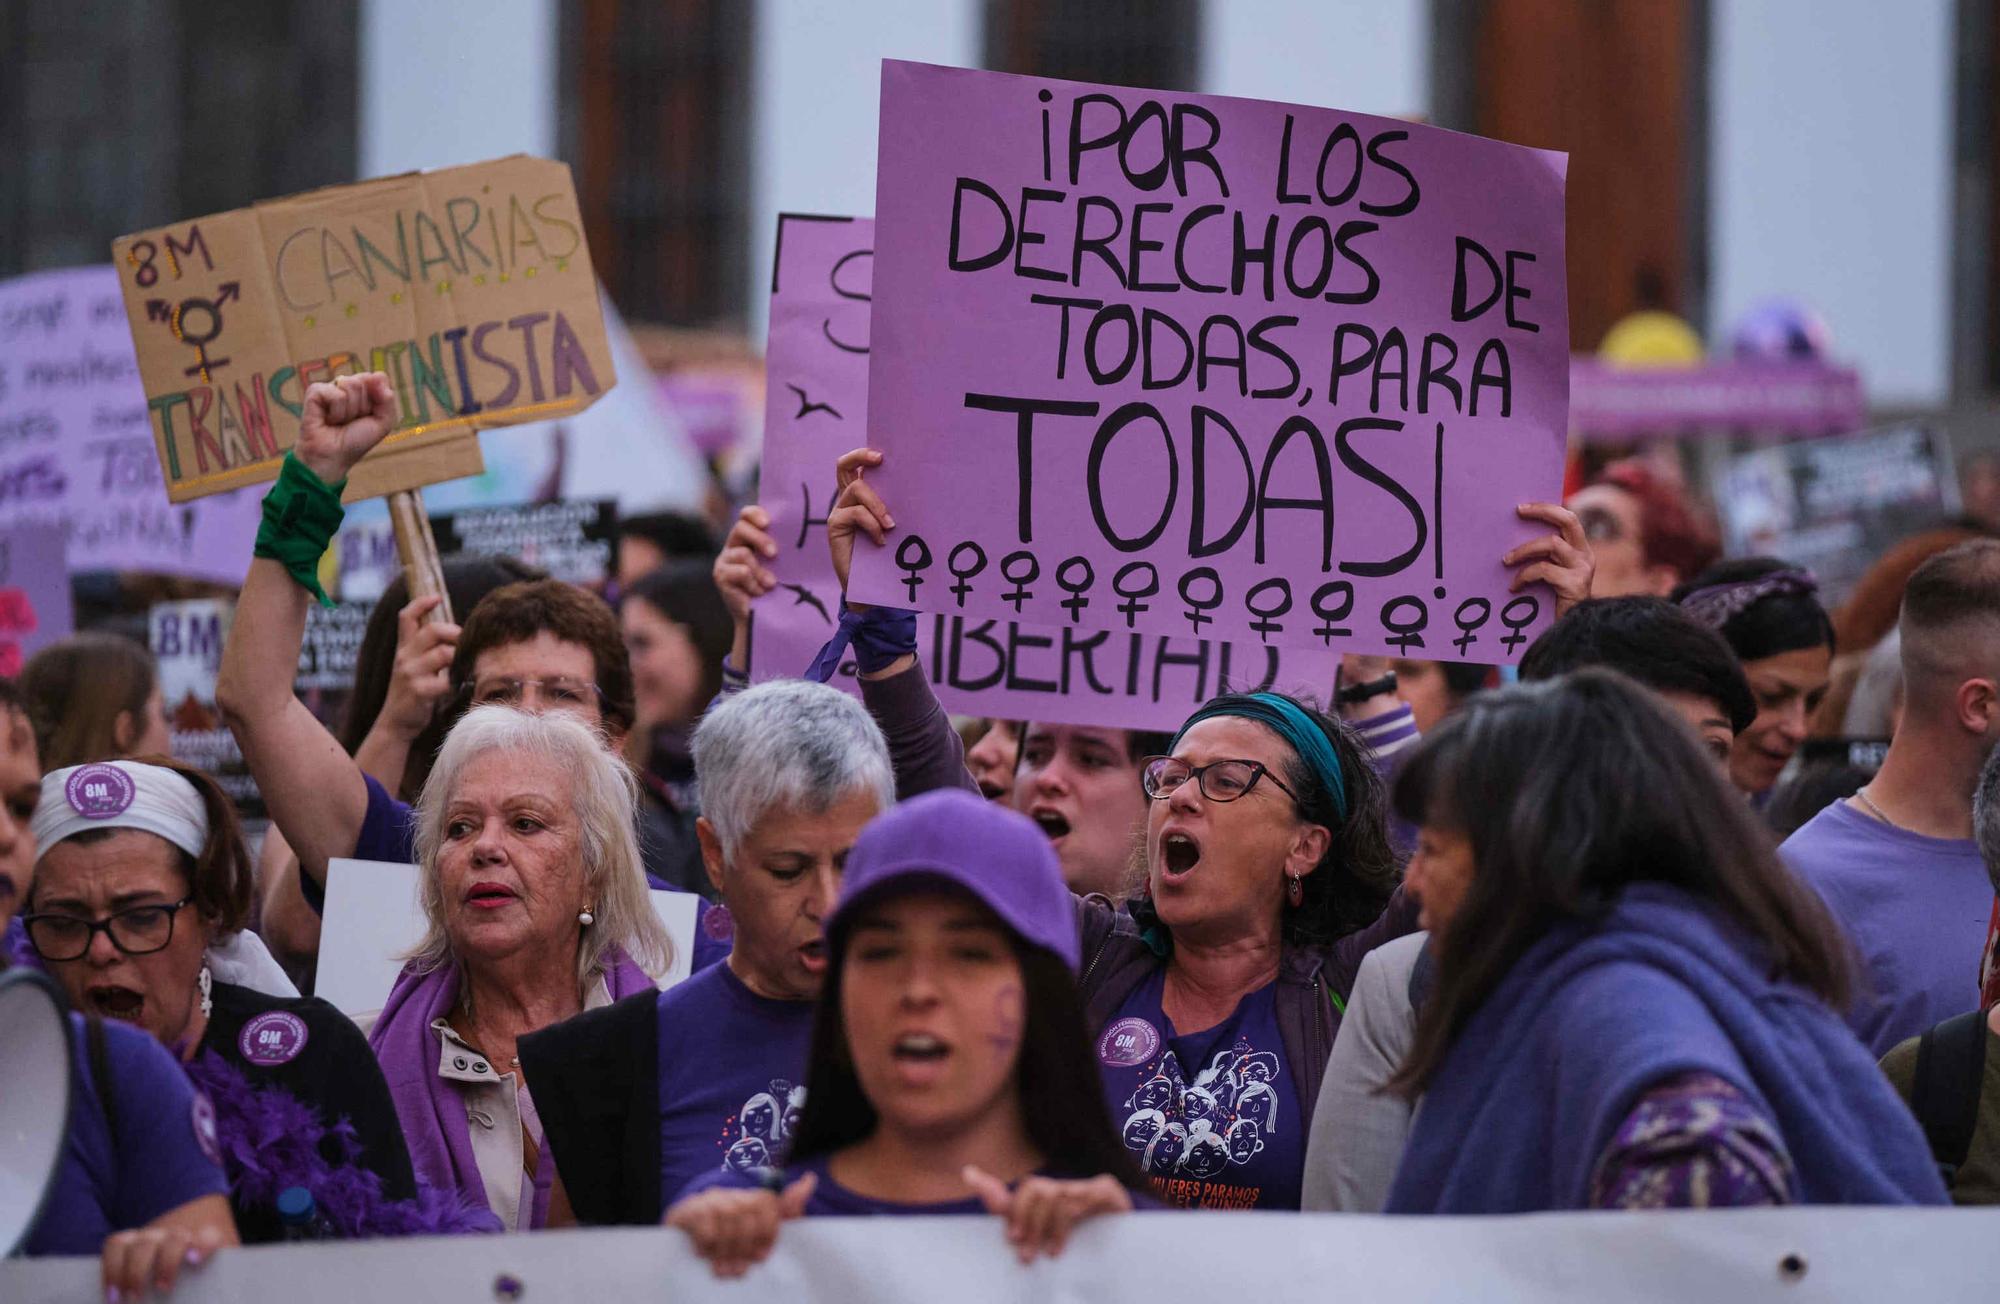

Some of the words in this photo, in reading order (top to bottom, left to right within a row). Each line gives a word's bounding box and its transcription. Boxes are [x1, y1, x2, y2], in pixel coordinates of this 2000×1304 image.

[1038, 89, 1230, 198] ¡POR
[1276, 113, 1421, 217] LOS
[127, 224, 214, 288] 8M
[948, 177, 1380, 304] DERECHOS
[1450, 236, 1541, 333] DE
[1031, 294, 1313, 408] TODAS,
[1328, 323, 1512, 419] PARA
[964, 393, 1447, 600] TODAS!
[158, 613, 221, 656] 8M
[931, 612, 1280, 703] IBERTAD
[85, 783, 108, 798] 8M
[259, 1030, 282, 1044] 8M
[1115, 1034, 1137, 1048] 8M
[1202, 1182, 1260, 1202] PARAMOS
